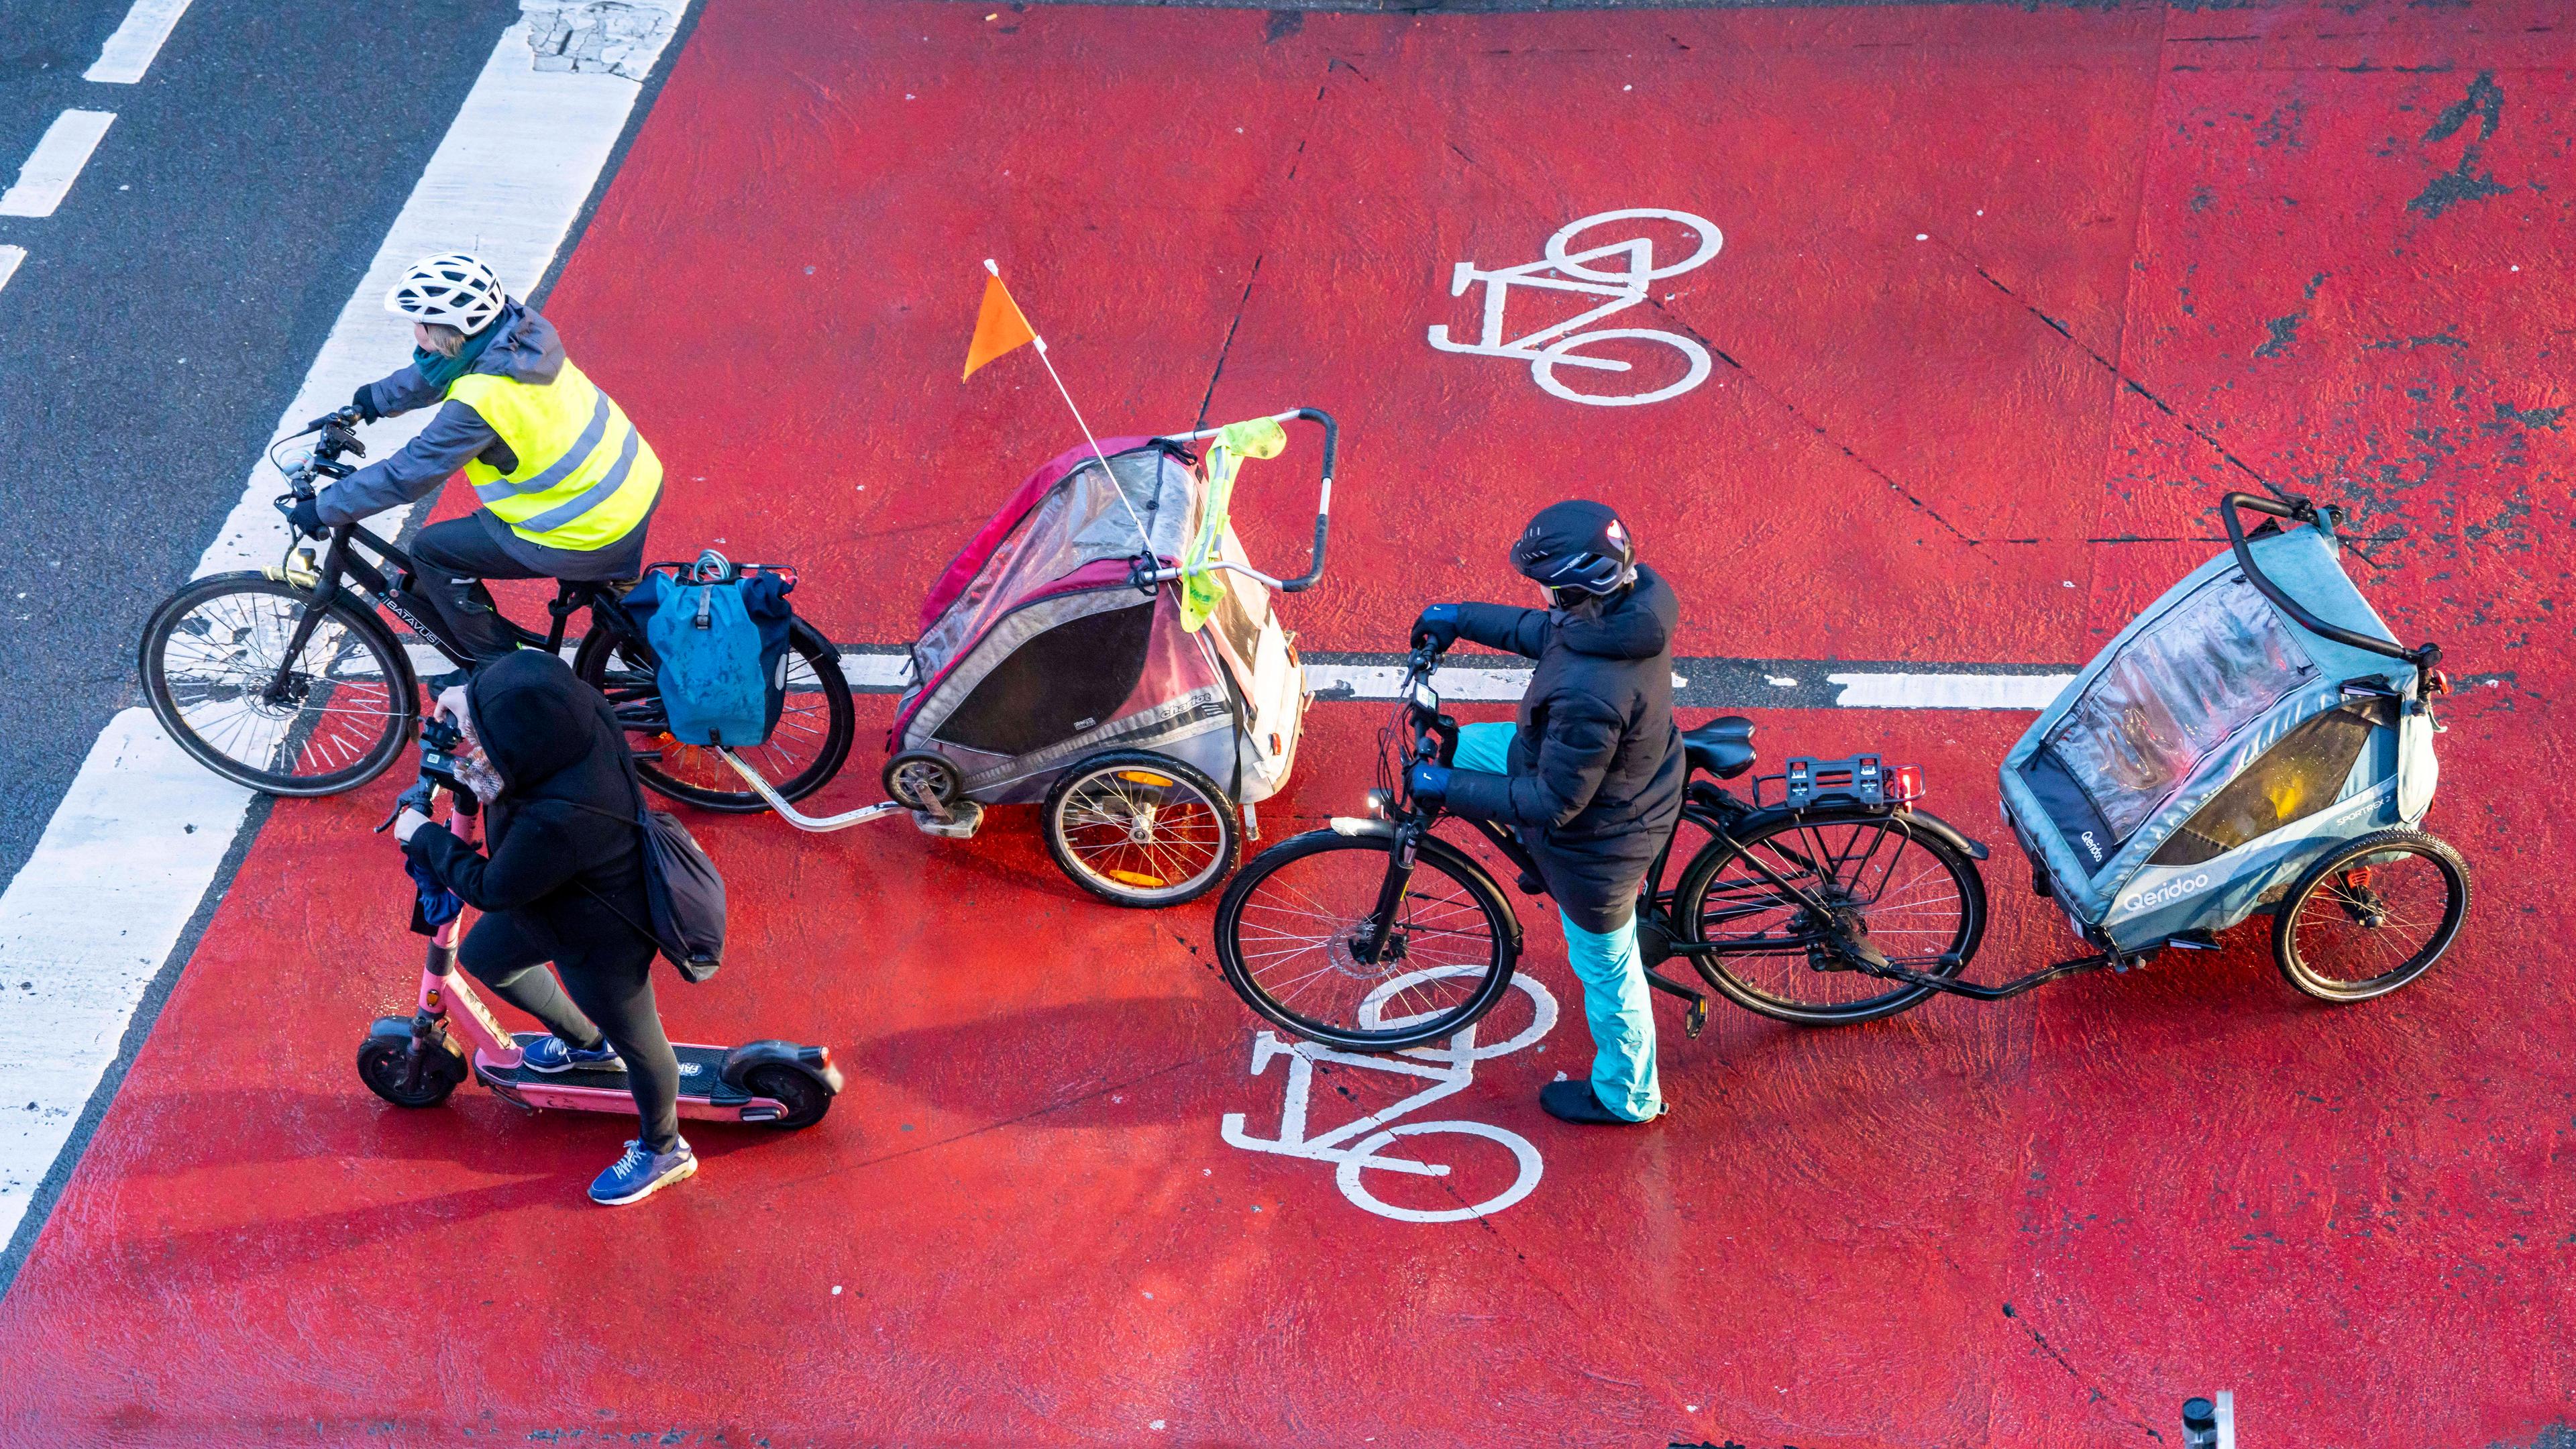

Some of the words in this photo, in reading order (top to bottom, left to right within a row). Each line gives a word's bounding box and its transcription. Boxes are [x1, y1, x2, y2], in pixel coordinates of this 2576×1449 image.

[386, 600, 437, 643] BATAVUS
[1160, 692, 1212, 719] chariot
[2337, 798, 2384, 826] SPORTREX
[2081, 830, 2103, 862] Qeridoo
[2124, 874, 2208, 912] Qeridoo
